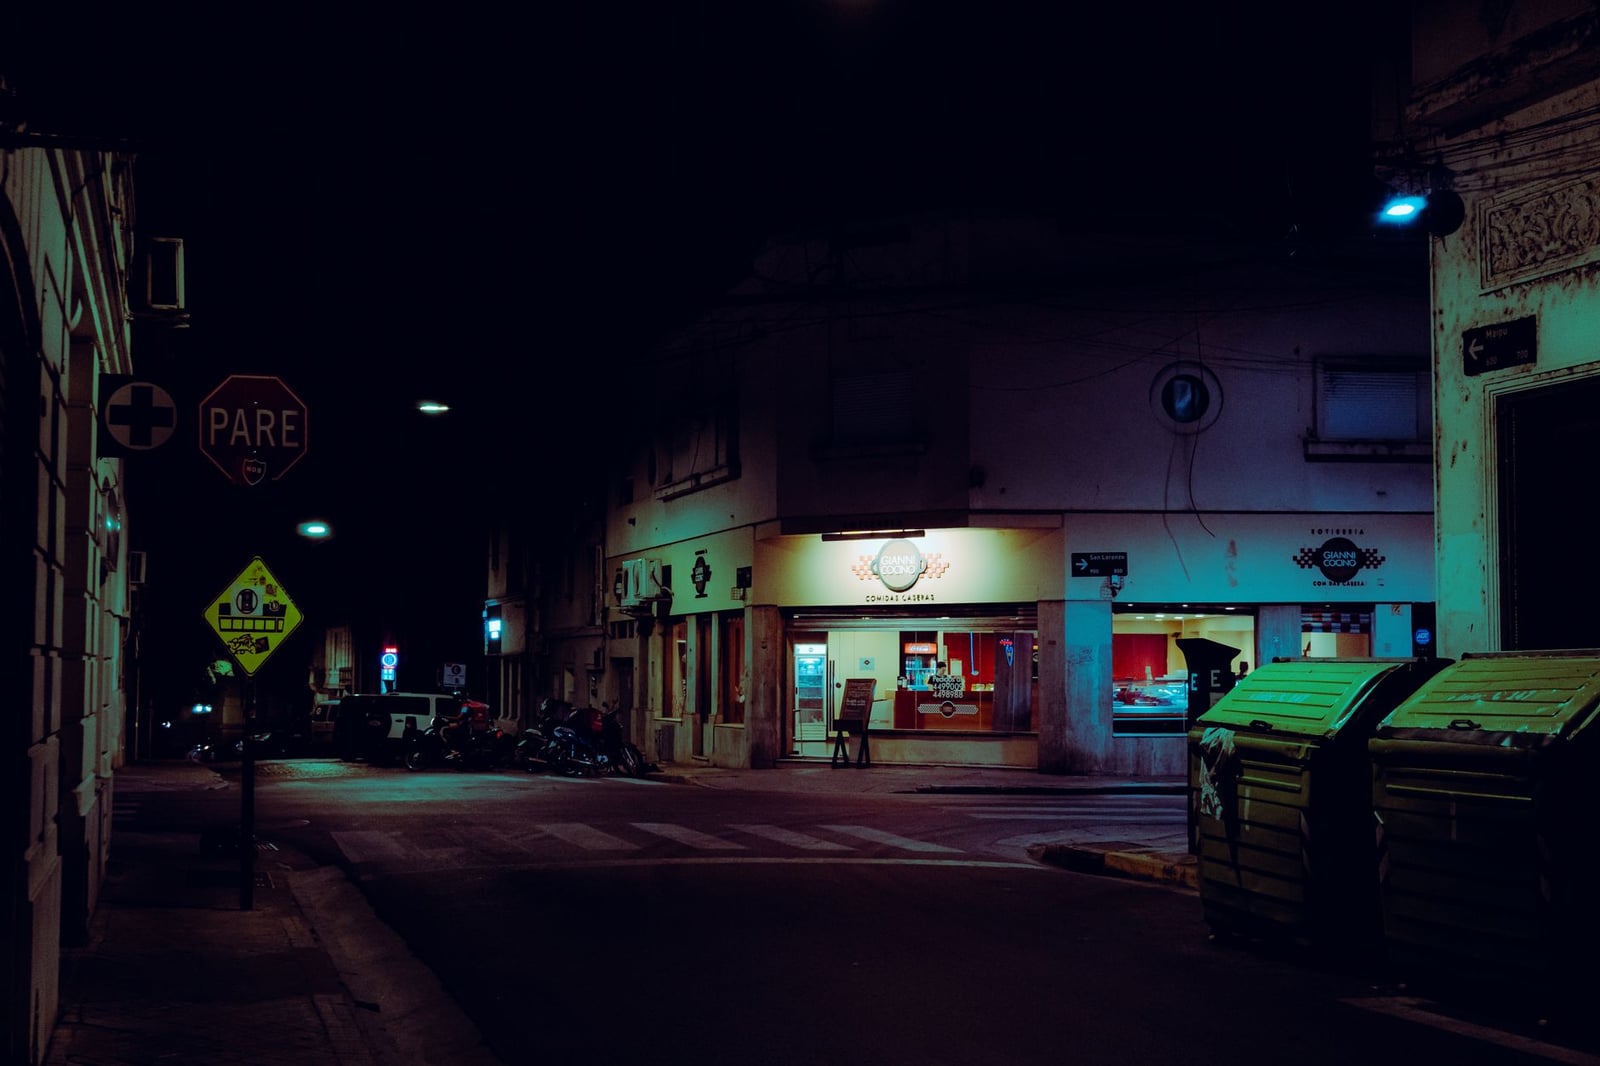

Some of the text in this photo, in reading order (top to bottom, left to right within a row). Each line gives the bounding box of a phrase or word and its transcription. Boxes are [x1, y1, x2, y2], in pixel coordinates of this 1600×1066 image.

[210, 407, 300, 447] PARE
[880, 554, 917, 565] GIANNI
[1323, 551, 1357, 560] GIANNI
[1323, 559, 1357, 567] COCINO
[880, 565, 917, 575] COCINO
[901, 593, 935, 601] CASERAS
[1190, 672, 1199, 692] E
[1210, 669, 1221, 688] E
